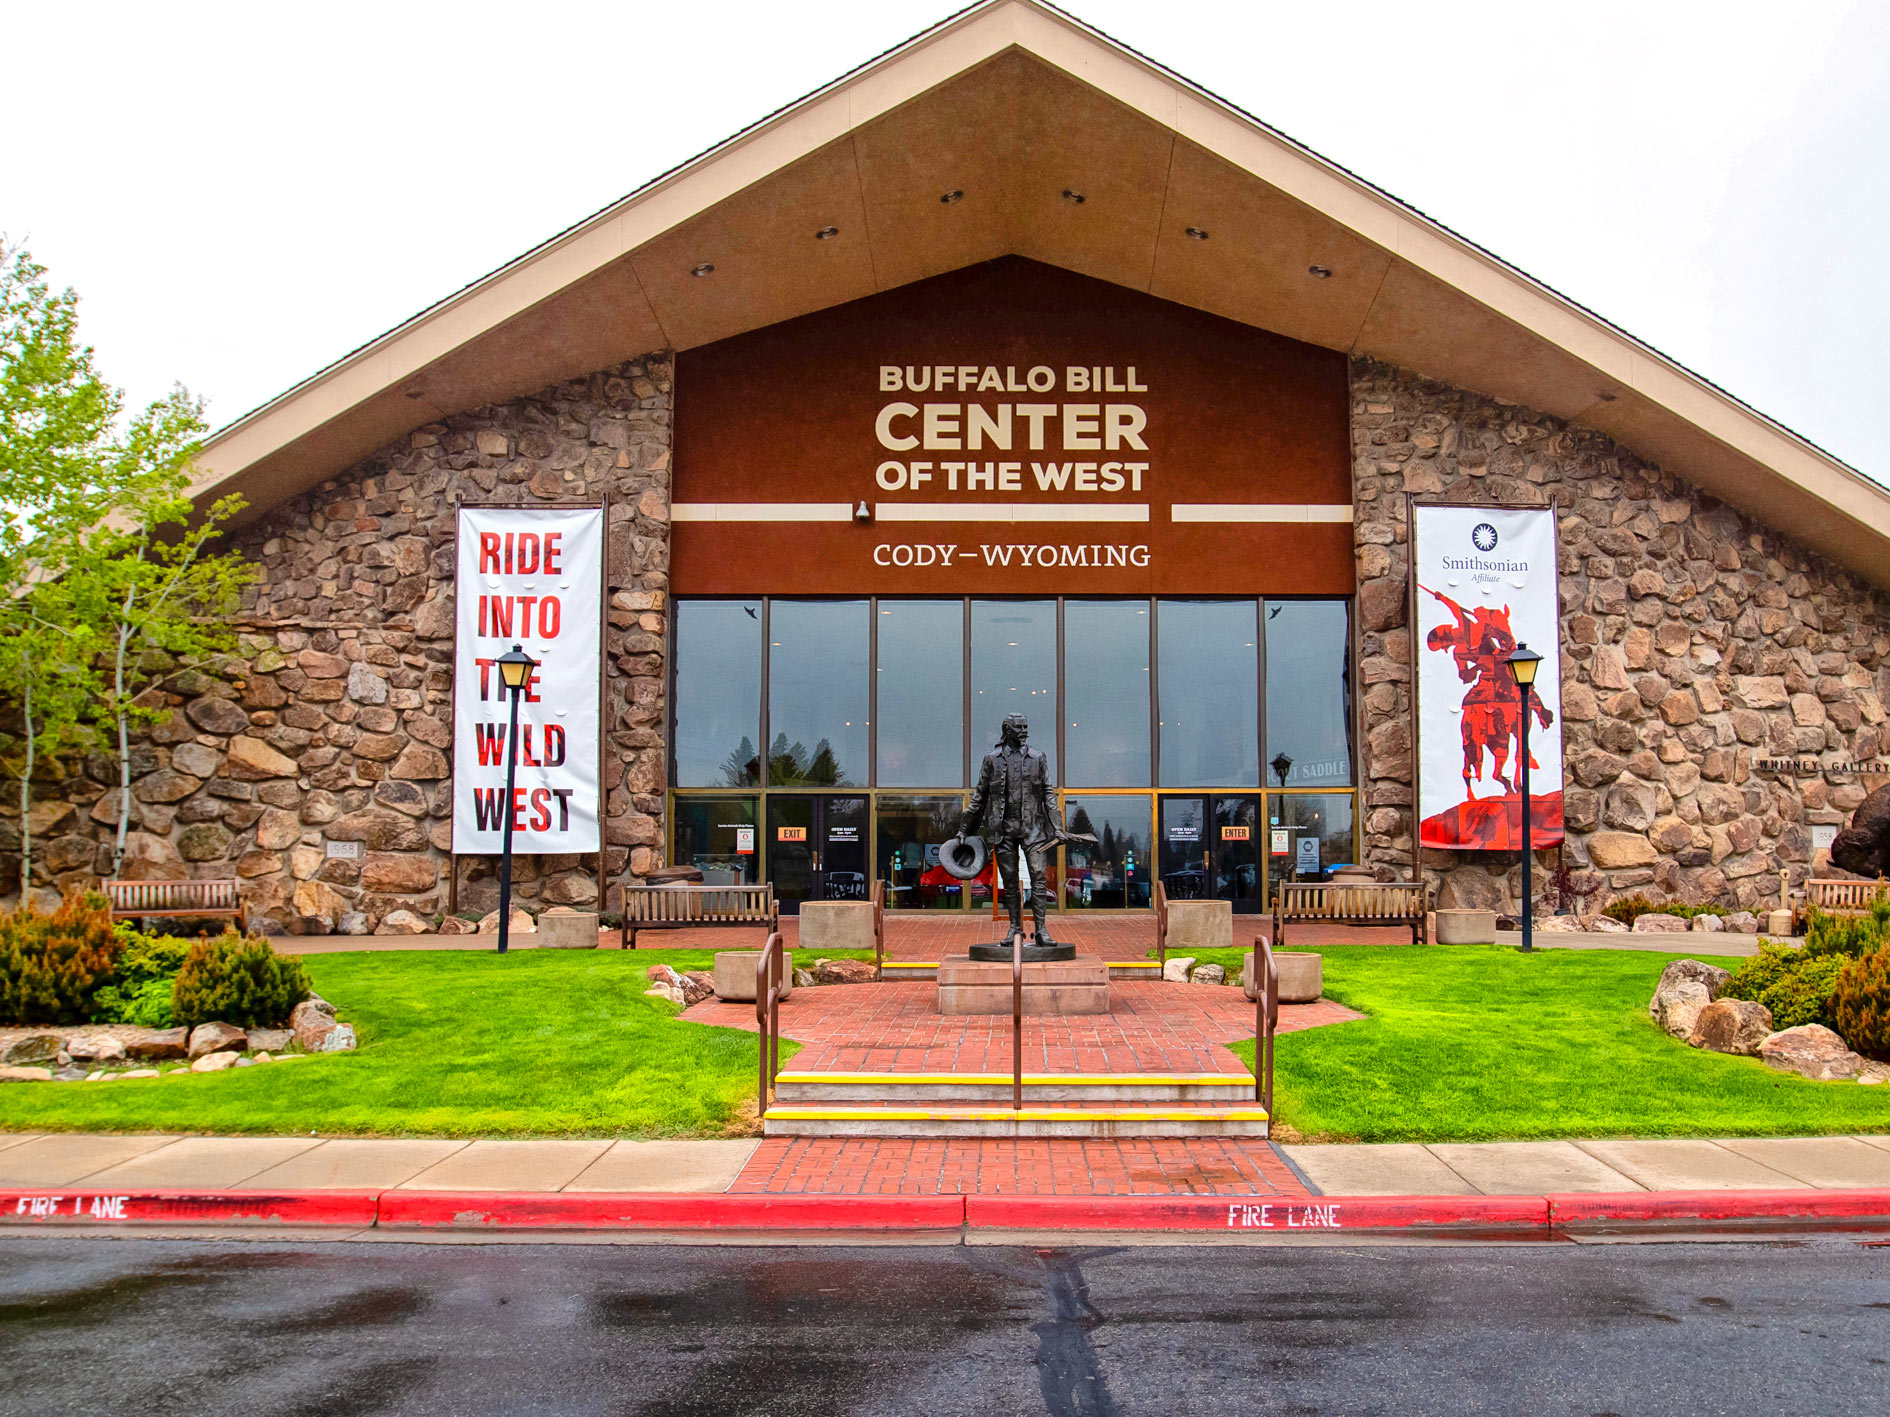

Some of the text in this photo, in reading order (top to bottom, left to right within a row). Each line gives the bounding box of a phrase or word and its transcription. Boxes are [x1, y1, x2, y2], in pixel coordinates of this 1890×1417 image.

[879, 365, 1148, 392] BUFFALO BILL
[875, 402, 1150, 451] CENTER
[875, 461, 1150, 492] OF THE WEST
[478, 531, 563, 575] RIDE
[1442, 556, 1529, 572] Smithsonian
[1471, 573, 1500, 584] Affiliate
[477, 594, 562, 639] INTO
[1302, 760, 1346, 779] SADDLE
[1760, 759, 1890, 774] WHITNEY GALLERY
[473, 787, 574, 832] WEST
[783, 829, 802, 839] EXIT
[1224, 828, 1247, 838] ENTER
[1228, 1204, 1342, 1228] FIRE LANE
